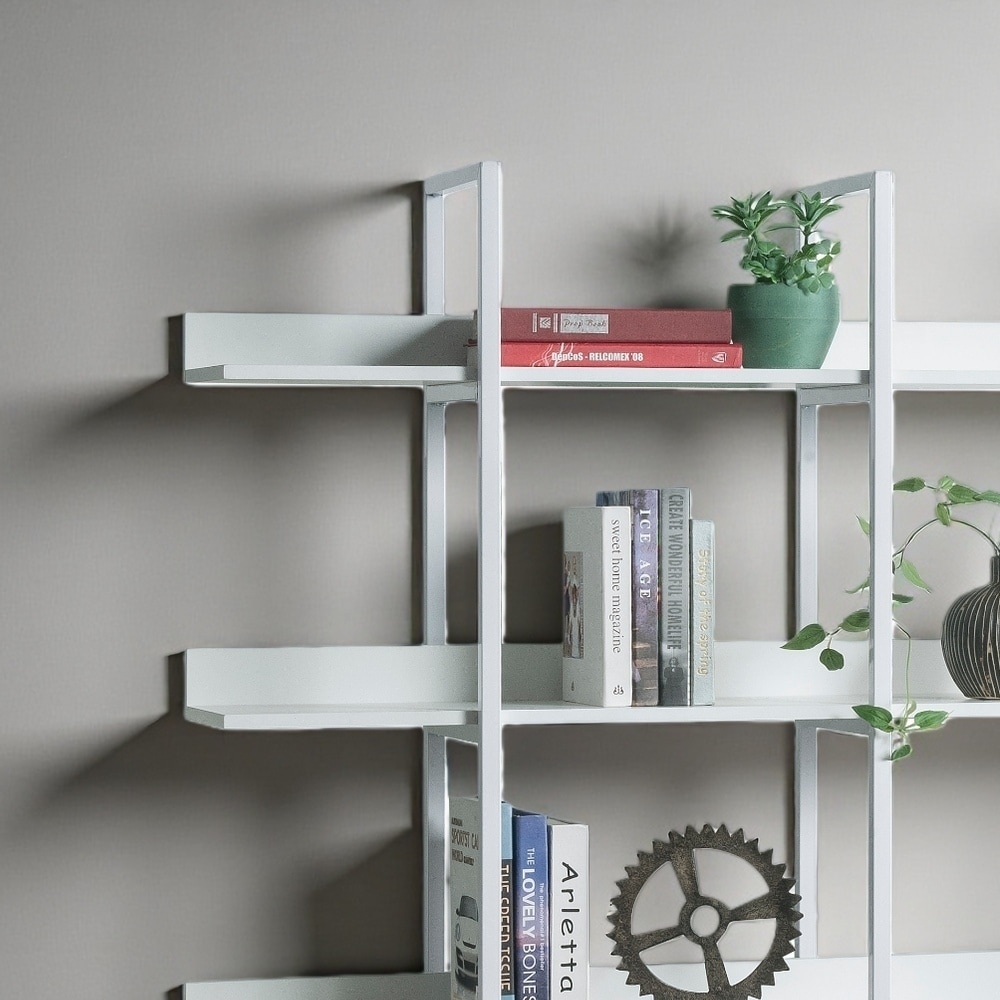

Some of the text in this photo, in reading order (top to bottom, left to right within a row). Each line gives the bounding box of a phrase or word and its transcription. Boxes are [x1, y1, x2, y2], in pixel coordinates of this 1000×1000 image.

[588, 352, 630, 362] RELCOMEX
[630, 352, 644, 362] '08
[608, 520, 624, 654] sweet home magazine
[640, 508, 651, 599] ICE AGE
[667, 494, 684, 650] CREATE WONDERFUL HOMELIFE
[527, 848, 535, 866] THE
[522, 868, 536, 939] LOVELY
[560, 862, 580, 993] Arletta
